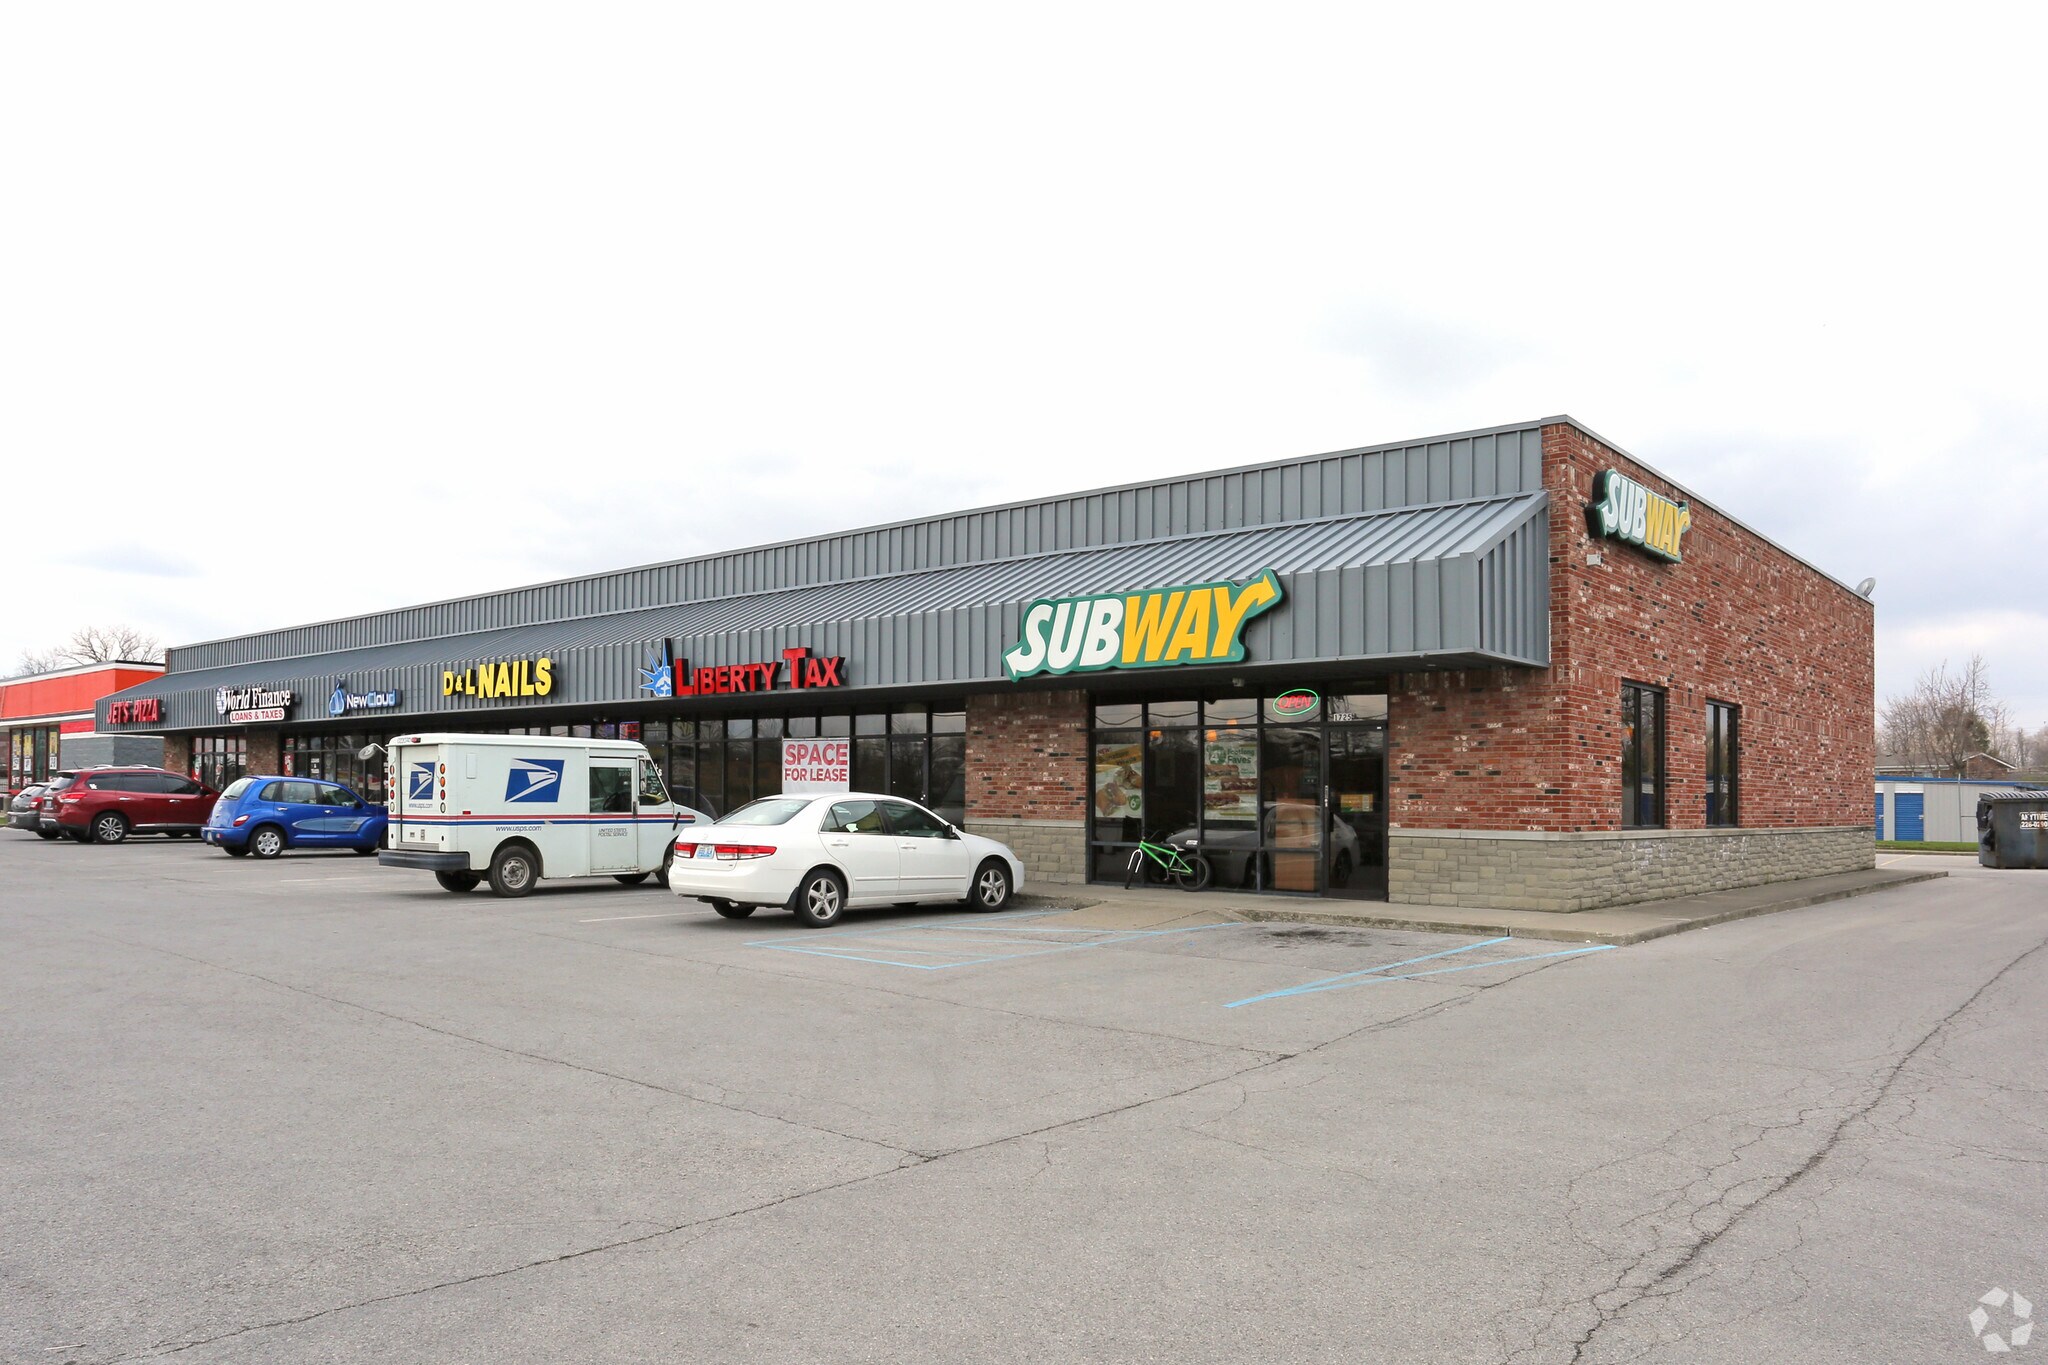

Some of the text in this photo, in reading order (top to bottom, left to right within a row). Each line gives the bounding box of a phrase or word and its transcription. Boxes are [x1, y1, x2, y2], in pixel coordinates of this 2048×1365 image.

[1602, 473, 1689, 557] SUBWAY
[1005, 574, 1275, 676] SUBWAY
[478, 657, 552, 698] NAILS
[675, 647, 842, 696] LIBERTY TAX
[224, 686, 291, 710] World Finance
[346, 688, 397, 709] NewCloud
[1278, 695, 1312, 709] OPEN
[107, 699, 160, 724] JET'S PIZZA
[231, 709, 284, 721] LOANS & TAXES
[1333, 712, 1353, 721] 1725
[784, 743, 848, 766] SPACE
[1227, 755, 1252, 764] Faves
[784, 768, 848, 782] FOR LEASE
